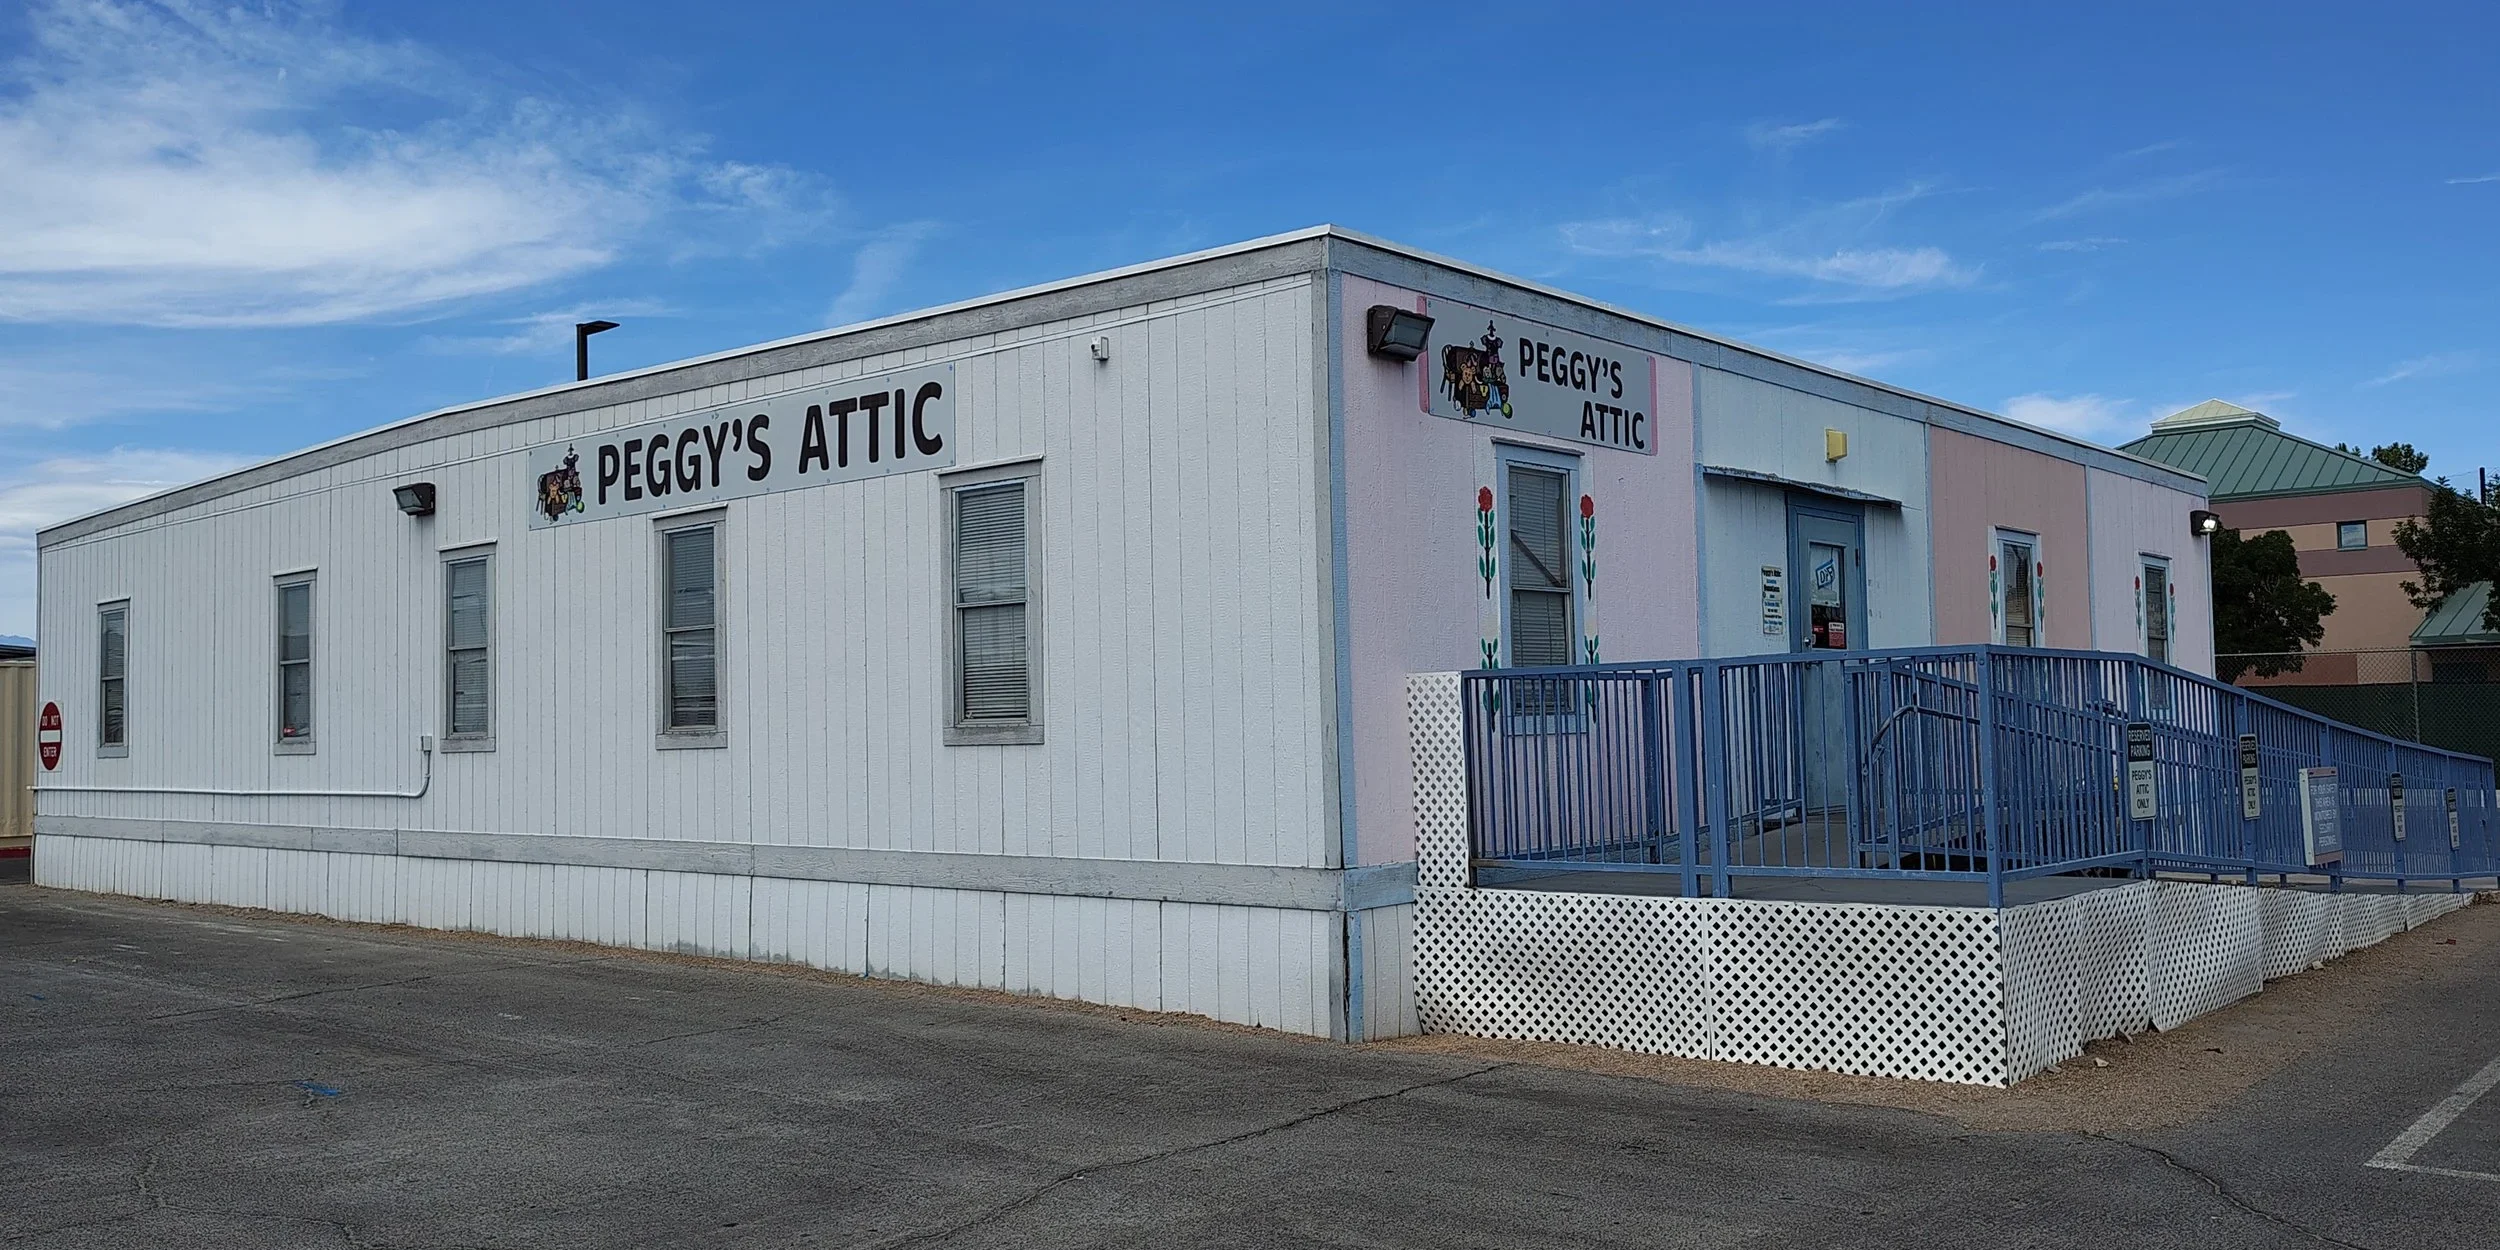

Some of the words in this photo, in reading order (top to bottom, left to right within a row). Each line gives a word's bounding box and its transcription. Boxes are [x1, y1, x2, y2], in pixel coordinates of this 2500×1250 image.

[1519, 337, 1623, 399] PEGGY'S
[1580, 400, 1645, 450] ATTIC
[598, 414, 772, 505] PEGGY'S
[798, 381, 943, 474] ATTIC
[51, 714, 59, 726] NOT
[2128, 729, 2151, 742] RESERVED
[43, 746, 57, 757] ENTER
[2130, 744, 2151, 757] PARKING
[2131, 769, 2152, 781] PEGGY'S
[2136, 784, 2149, 795] ATTIC
[2136, 798, 2149, 809] ONLY
